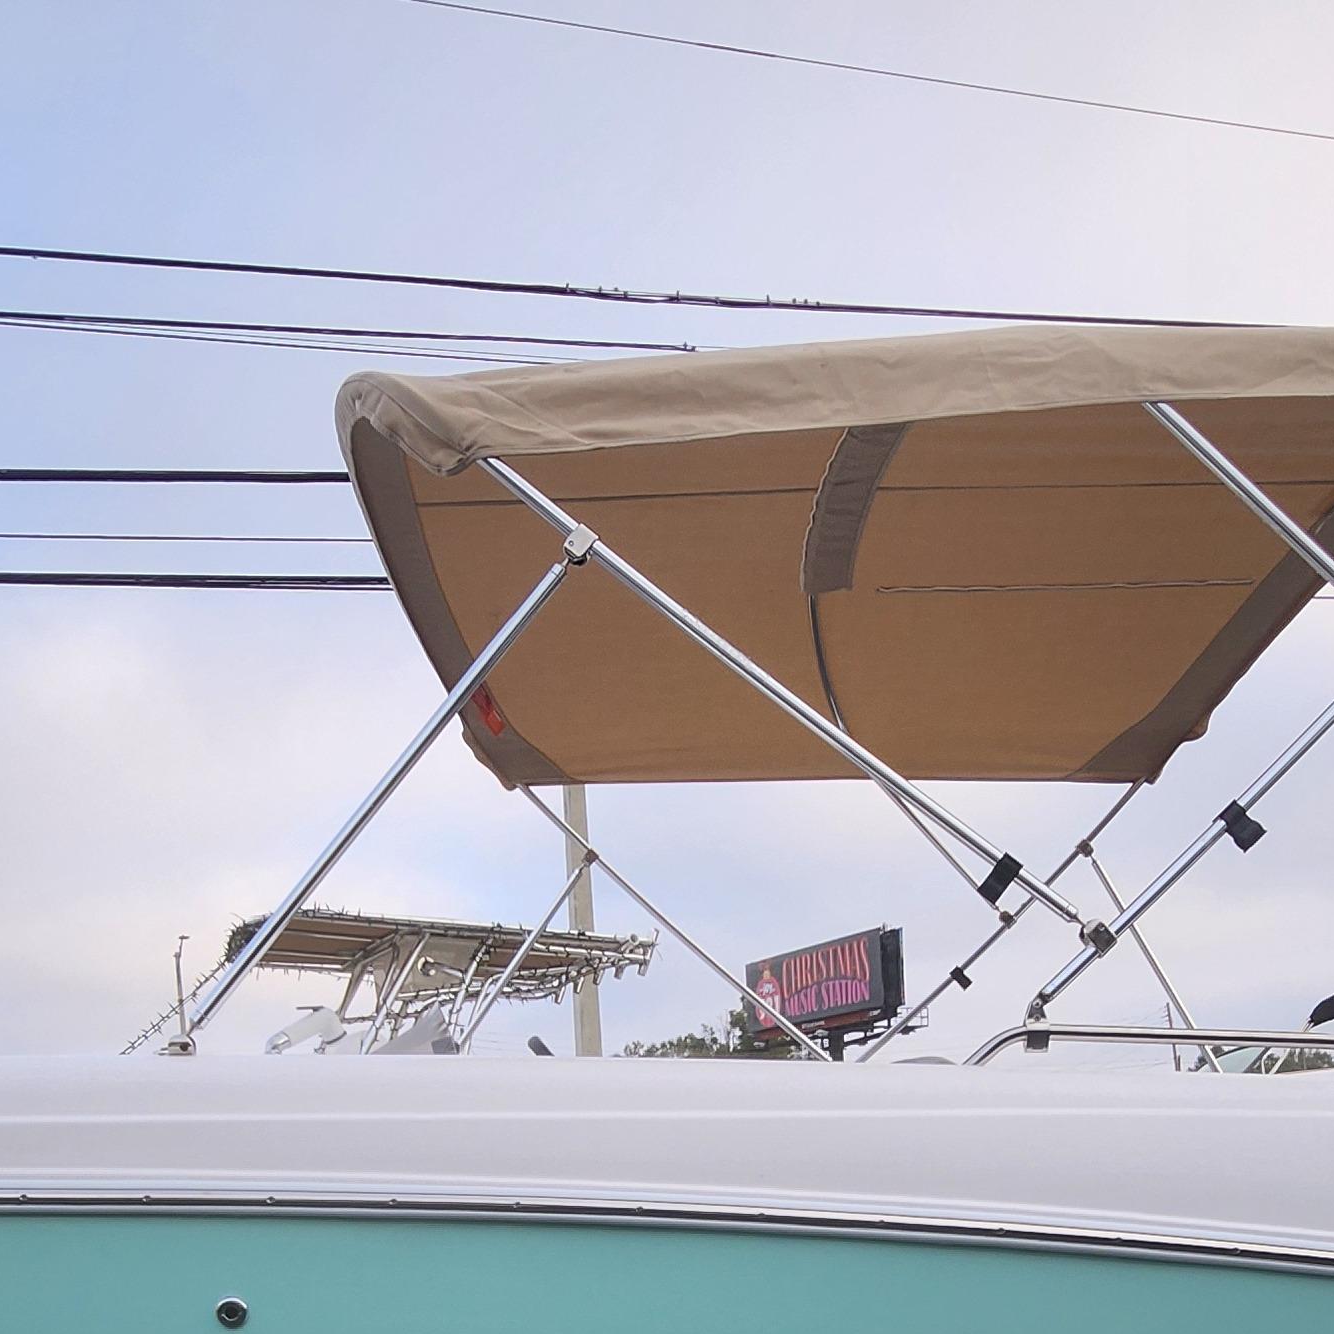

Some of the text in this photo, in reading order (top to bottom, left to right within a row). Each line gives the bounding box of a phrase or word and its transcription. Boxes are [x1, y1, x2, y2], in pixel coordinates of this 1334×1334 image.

[782, 937, 870, 999] CHRISTMAS
[784, 983, 818, 1017] MUSIC
[821, 978, 871, 1010] STATION
